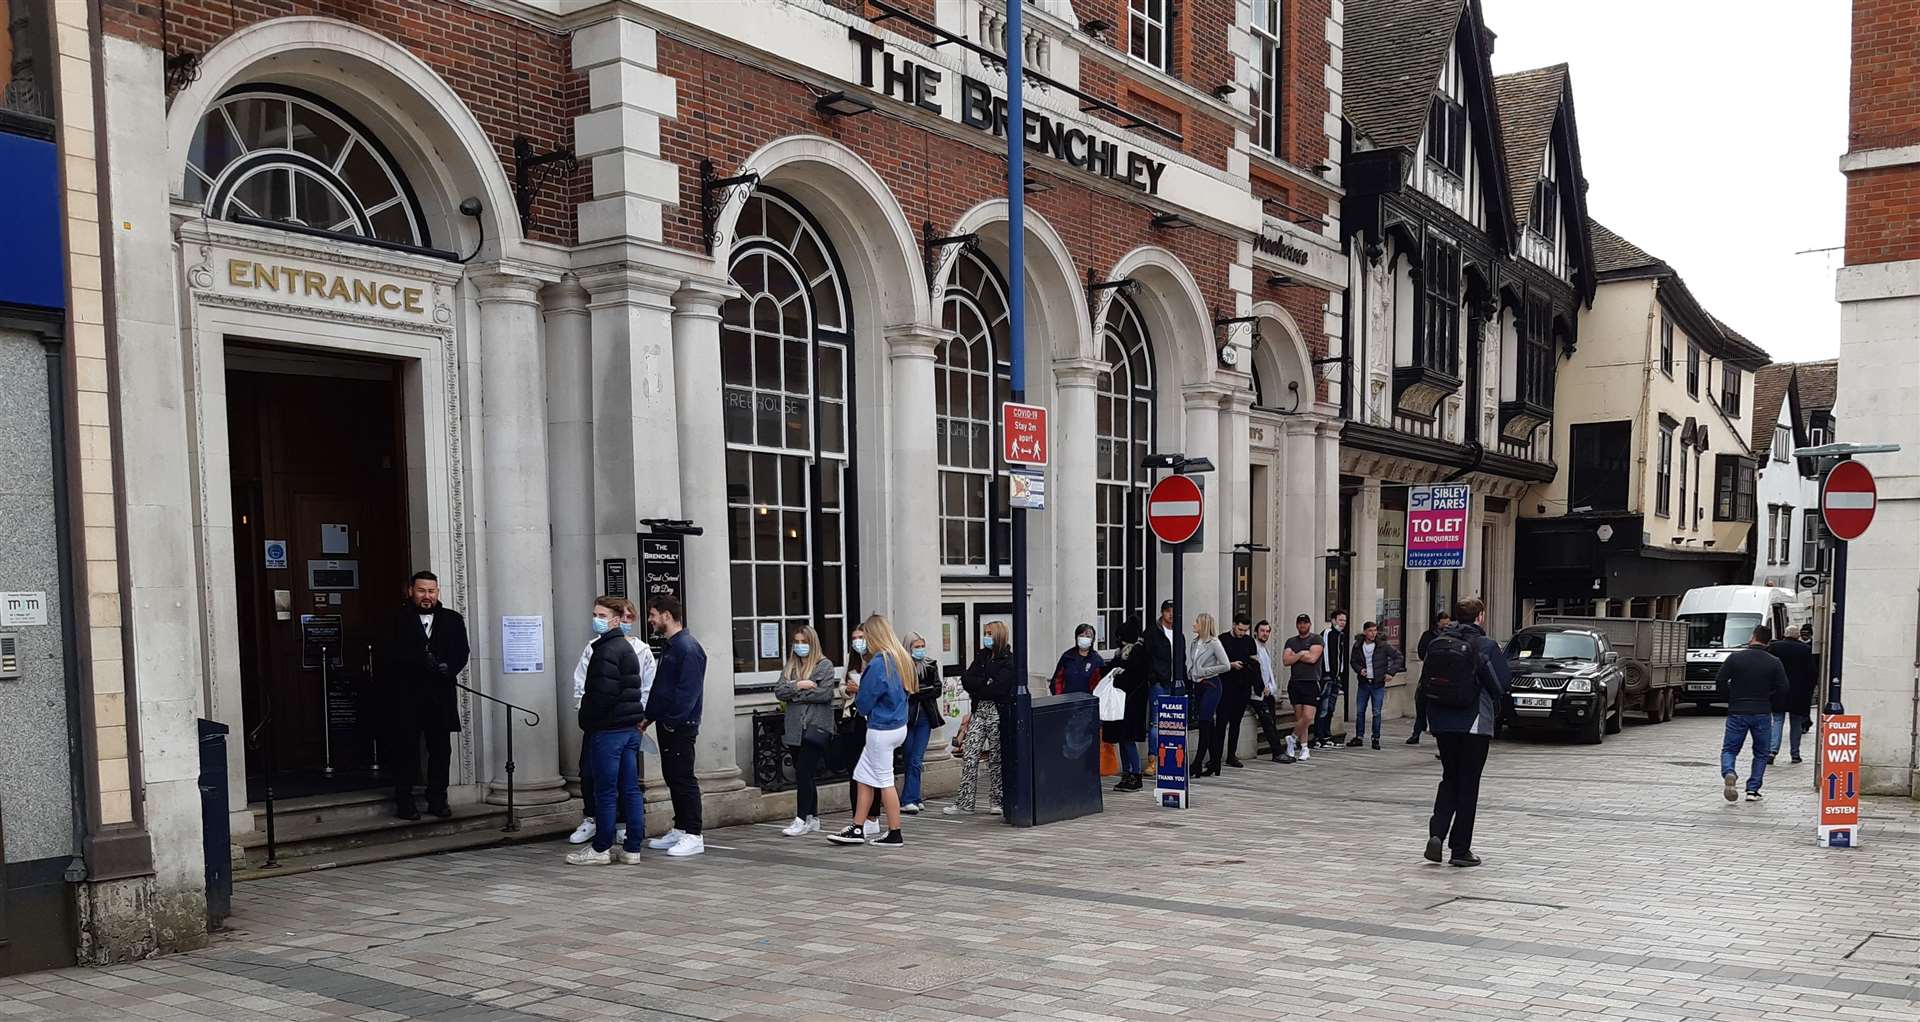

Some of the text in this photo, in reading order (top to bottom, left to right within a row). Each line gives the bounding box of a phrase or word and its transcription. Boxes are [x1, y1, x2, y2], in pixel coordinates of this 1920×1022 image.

[849, 26, 1167, 195] THE BRENCHLEY
[228, 258, 425, 314] ENTRANCE
[1013, 408, 1038, 420] COVID-19
[1014, 421, 1037, 432] Stay 2m
[1018, 434, 1034, 443] apart
[1434, 486, 1466, 499] SIBLEY
[1433, 498, 1466, 510] PARES
[1411, 518, 1463, 533] TO LET
[1413, 535, 1460, 544] ALL ENQUIRIES
[655, 543, 668, 551] THE
[643, 552, 679, 560] BRENCHLEY
[1237, 566, 1248, 592] H
[1828, 722, 1858, 730] FOLLOW
[1828, 732, 1858, 747] ONE
[1827, 749, 1858, 763] WAY
[1158, 774, 1185, 783] THANK YOU
[1825, 806, 1857, 815] SYSTEM
